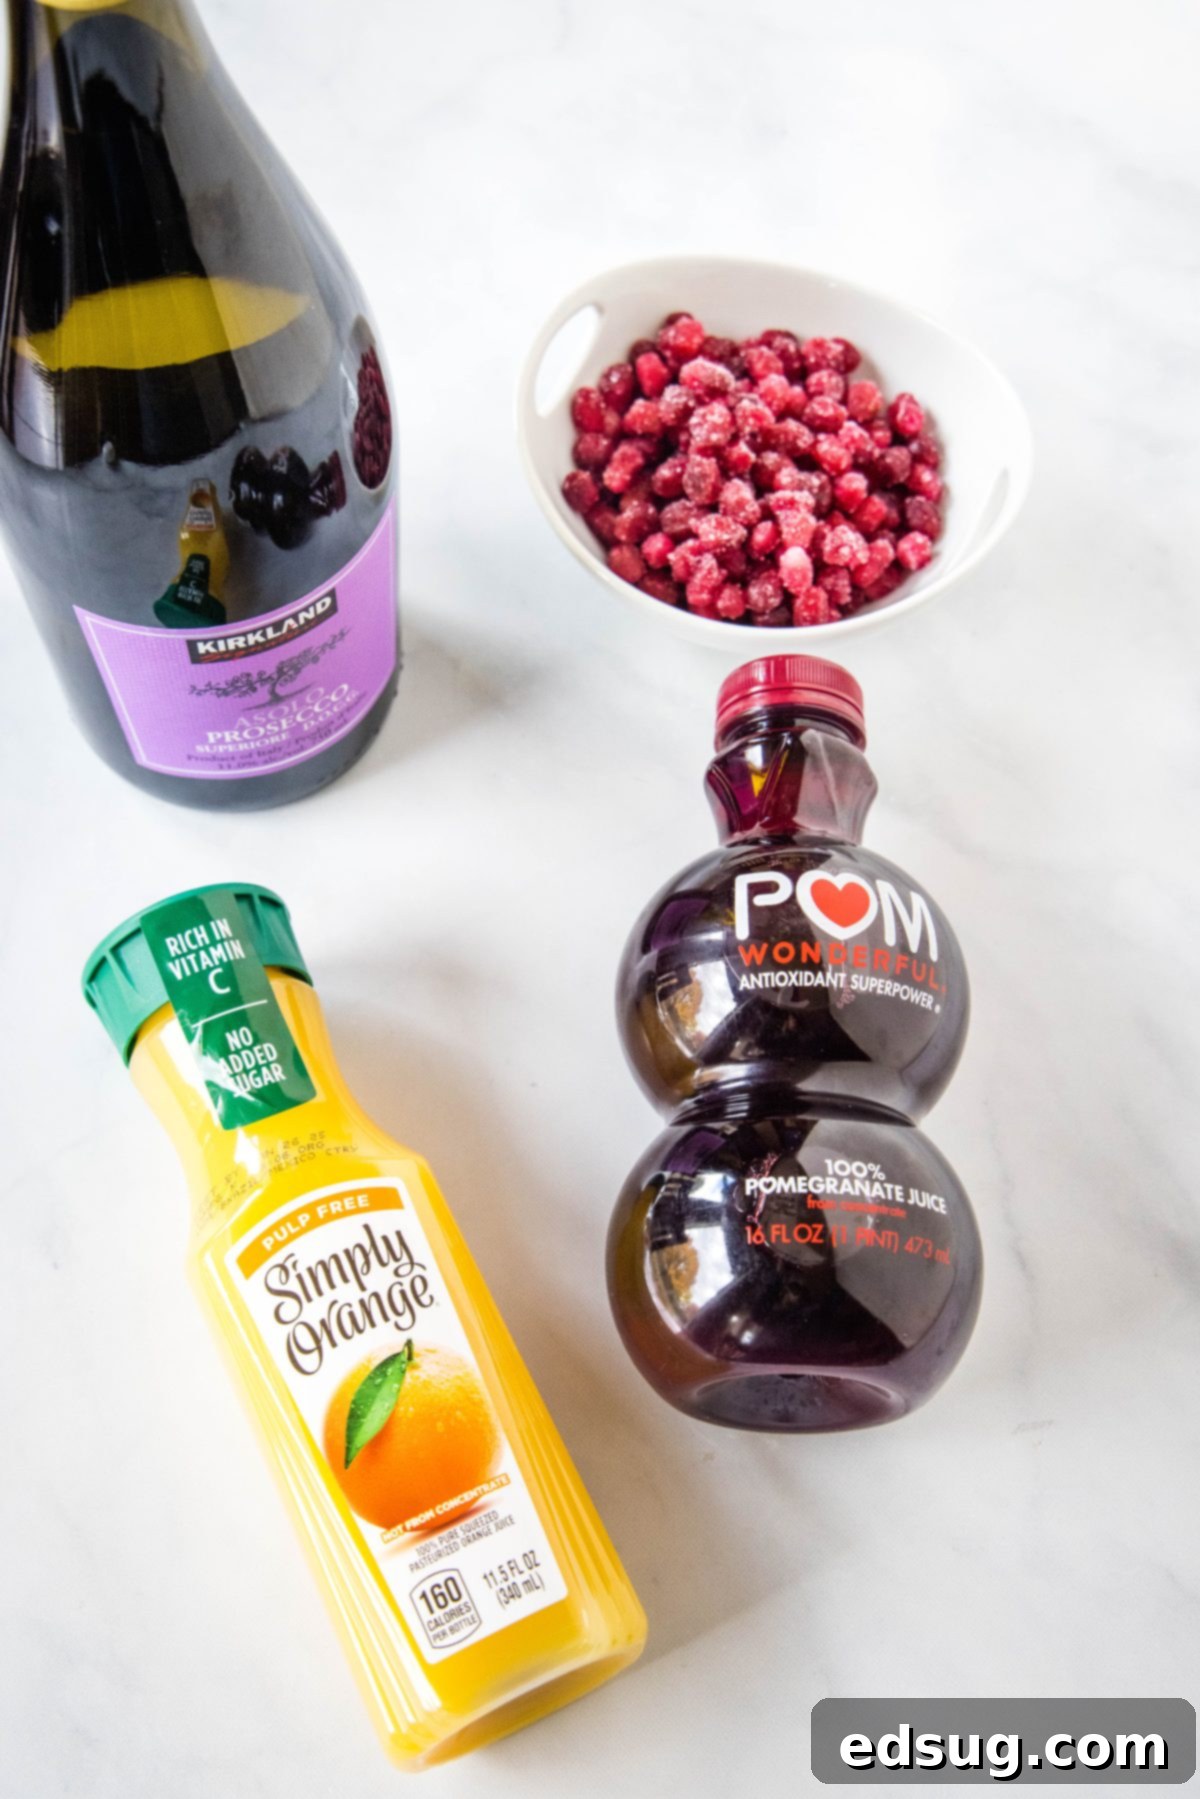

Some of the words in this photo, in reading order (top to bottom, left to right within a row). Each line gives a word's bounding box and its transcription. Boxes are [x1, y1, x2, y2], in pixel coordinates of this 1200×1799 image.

[196, 597, 332, 654] KIRKLAND
[206, 683, 349, 744] PROSECCO
[235, 687, 325, 730] ASOLO
[195, 732, 290, 753] SUPERIORE
[734, 869, 938, 962] POM
[165, 925, 210, 957] RICH
[210, 918, 233, 940] IN
[167, 940, 246, 981] VITAMIN
[208, 968, 231, 995] C
[739, 970, 846, 991] ANTIOXIDANT
[851, 973, 934, 1010] SUPERPOWER
[225, 1026, 254, 1052] NO
[218, 1042, 278, 1077] ADDED
[229, 1062, 287, 1097] UGAR
[824, 1158, 886, 1181] 100%
[744, 1175, 904, 1203] POMEGRANATE
[907, 1187, 948, 1215] JUICE
[261, 1213, 311, 1251] PULP
[316, 1194, 370, 1219] FREE
[745, 1224, 766, 1246] 16
[770, 1224, 791, 1244] FL
[793, 1224, 825, 1245] OZ
[904, 1235, 933, 1259] 473
[264, 1223, 427, 1325] Simply
[286, 1274, 435, 1376] Orange
[405, 1508, 436, 1531] FROM
[435, 1476, 510, 1515] CONCENTRATE
[408, 1540, 461, 1573] PASTEURIZED
[460, 1526, 493, 1548] ORANGE
[494, 1514, 516, 1534] JUICE
[415, 1541, 438, 1557] 100%
[437, 1526, 460, 1545] PURE
[459, 1509, 500, 1535] SQUEEZED
[482, 1565, 510, 1589] 11.5
[507, 1557, 525, 1578] FL
[522, 1549, 541, 1569] OZ
[419, 1575, 463, 1615] 160
[495, 1584, 523, 1610] (340
[521, 1572, 546, 1597] mL)
[426, 1601, 472, 1632] CALORIES
[432, 1629, 450, 1644] PER
[449, 1614, 478, 1638] BOTTLE
